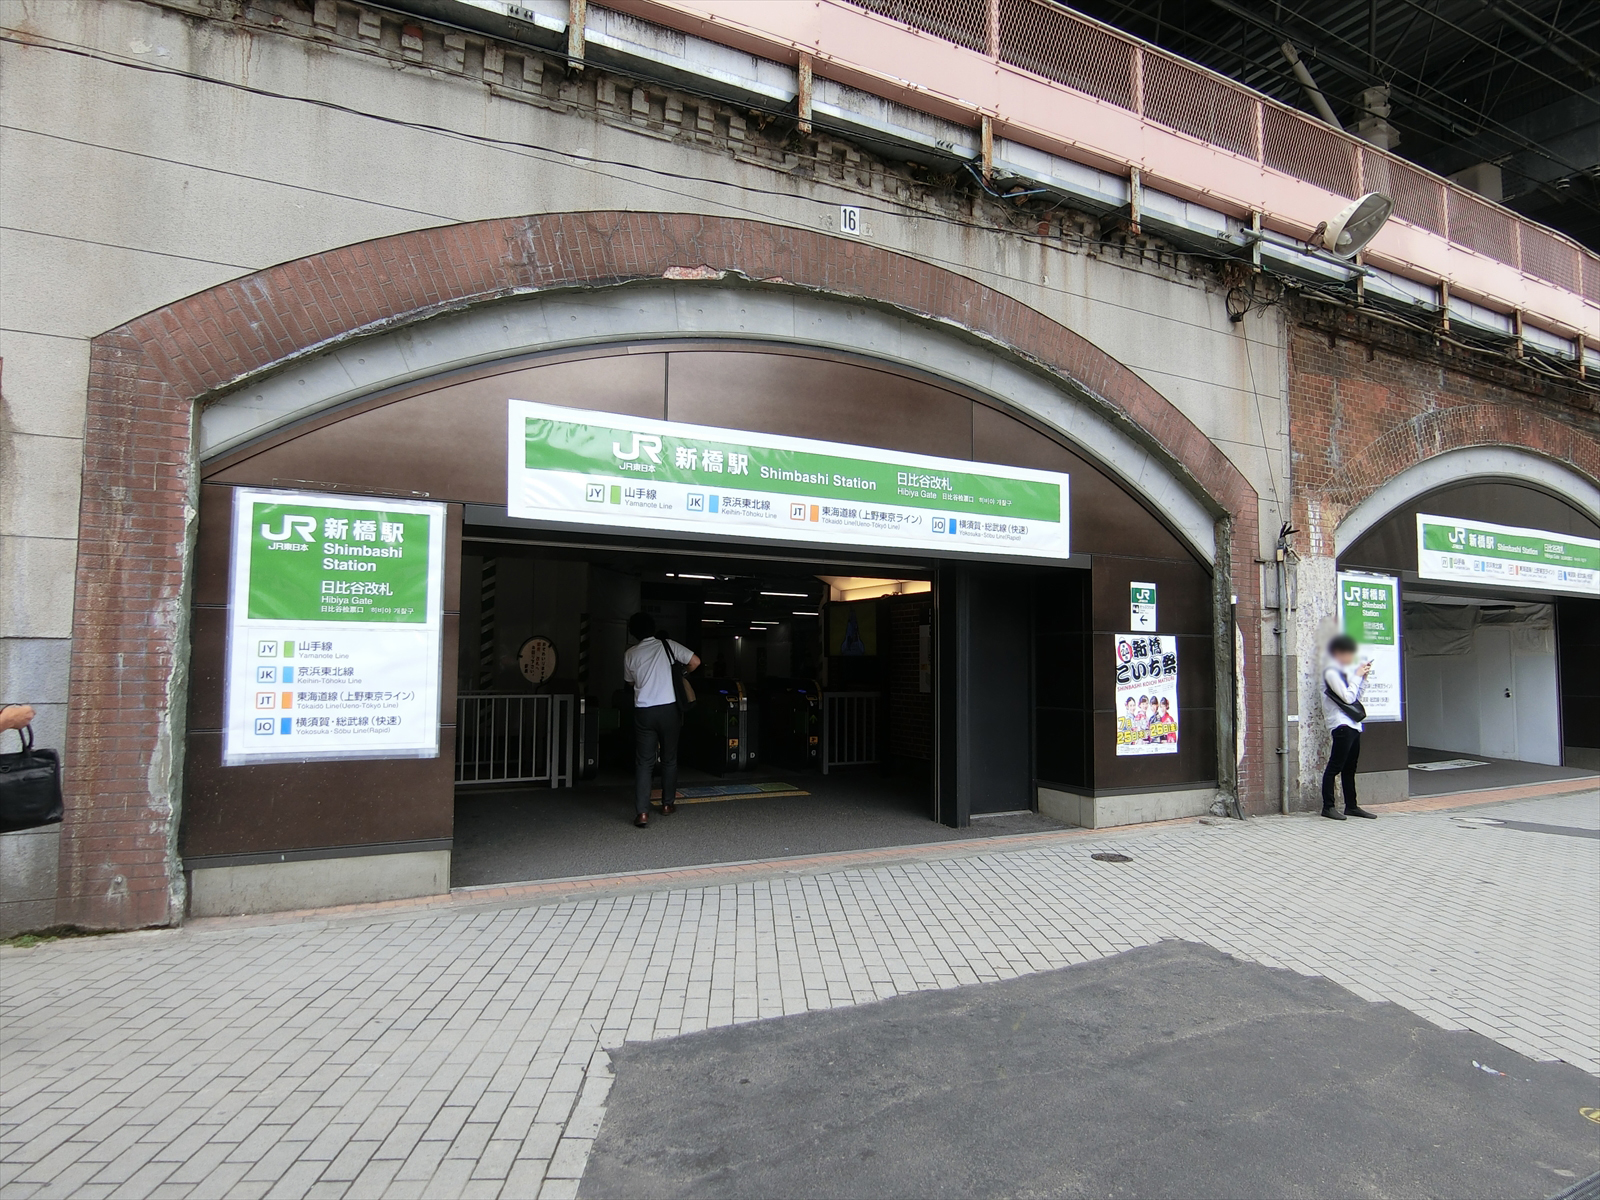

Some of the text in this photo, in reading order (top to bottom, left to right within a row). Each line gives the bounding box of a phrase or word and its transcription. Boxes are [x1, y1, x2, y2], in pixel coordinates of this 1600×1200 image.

[843, 208, 856, 230] 16
[612, 433, 662, 464] JR
[675, 446, 749, 476] 新橋駅
[618, 462, 656, 473] JR東日本
[760, 466, 876, 491] Shimbashi Station
[897, 472, 952, 491] 日比谷改札
[588, 488, 602, 498] JY
[625, 488, 657, 500] 山手線
[897, 488, 937, 500] Hibiya Gate
[625, 500, 656, 508] Yamanote
[690, 497, 701, 507] JK
[722, 496, 771, 510] 京浜東北線
[793, 508, 802, 516] JT
[261, 514, 317, 542] JR
[324, 518, 404, 543] 新橋駅
[1448, 527, 1466, 544] JR
[268, 542, 309, 551] JR東日本
[324, 543, 403, 558] Shimbashi
[323, 558, 376, 572] Station
[321, 580, 393, 596] 日比谷改札
[1344, 586, 1360, 602] JR
[321, 596, 373, 605] Hibiya Gate
[1137, 590, 1150, 600] JR
[261, 644, 274, 653] JY
[299, 641, 333, 651] 山手線
[1132, 637, 1162, 658] 新橋
[260, 670, 273, 679] JK
[298, 667, 354, 676] 京浜東北線
[1116, 654, 1176, 683] こいち祭
[260, 696, 272, 705] JT
[258, 722, 272, 731] JO
